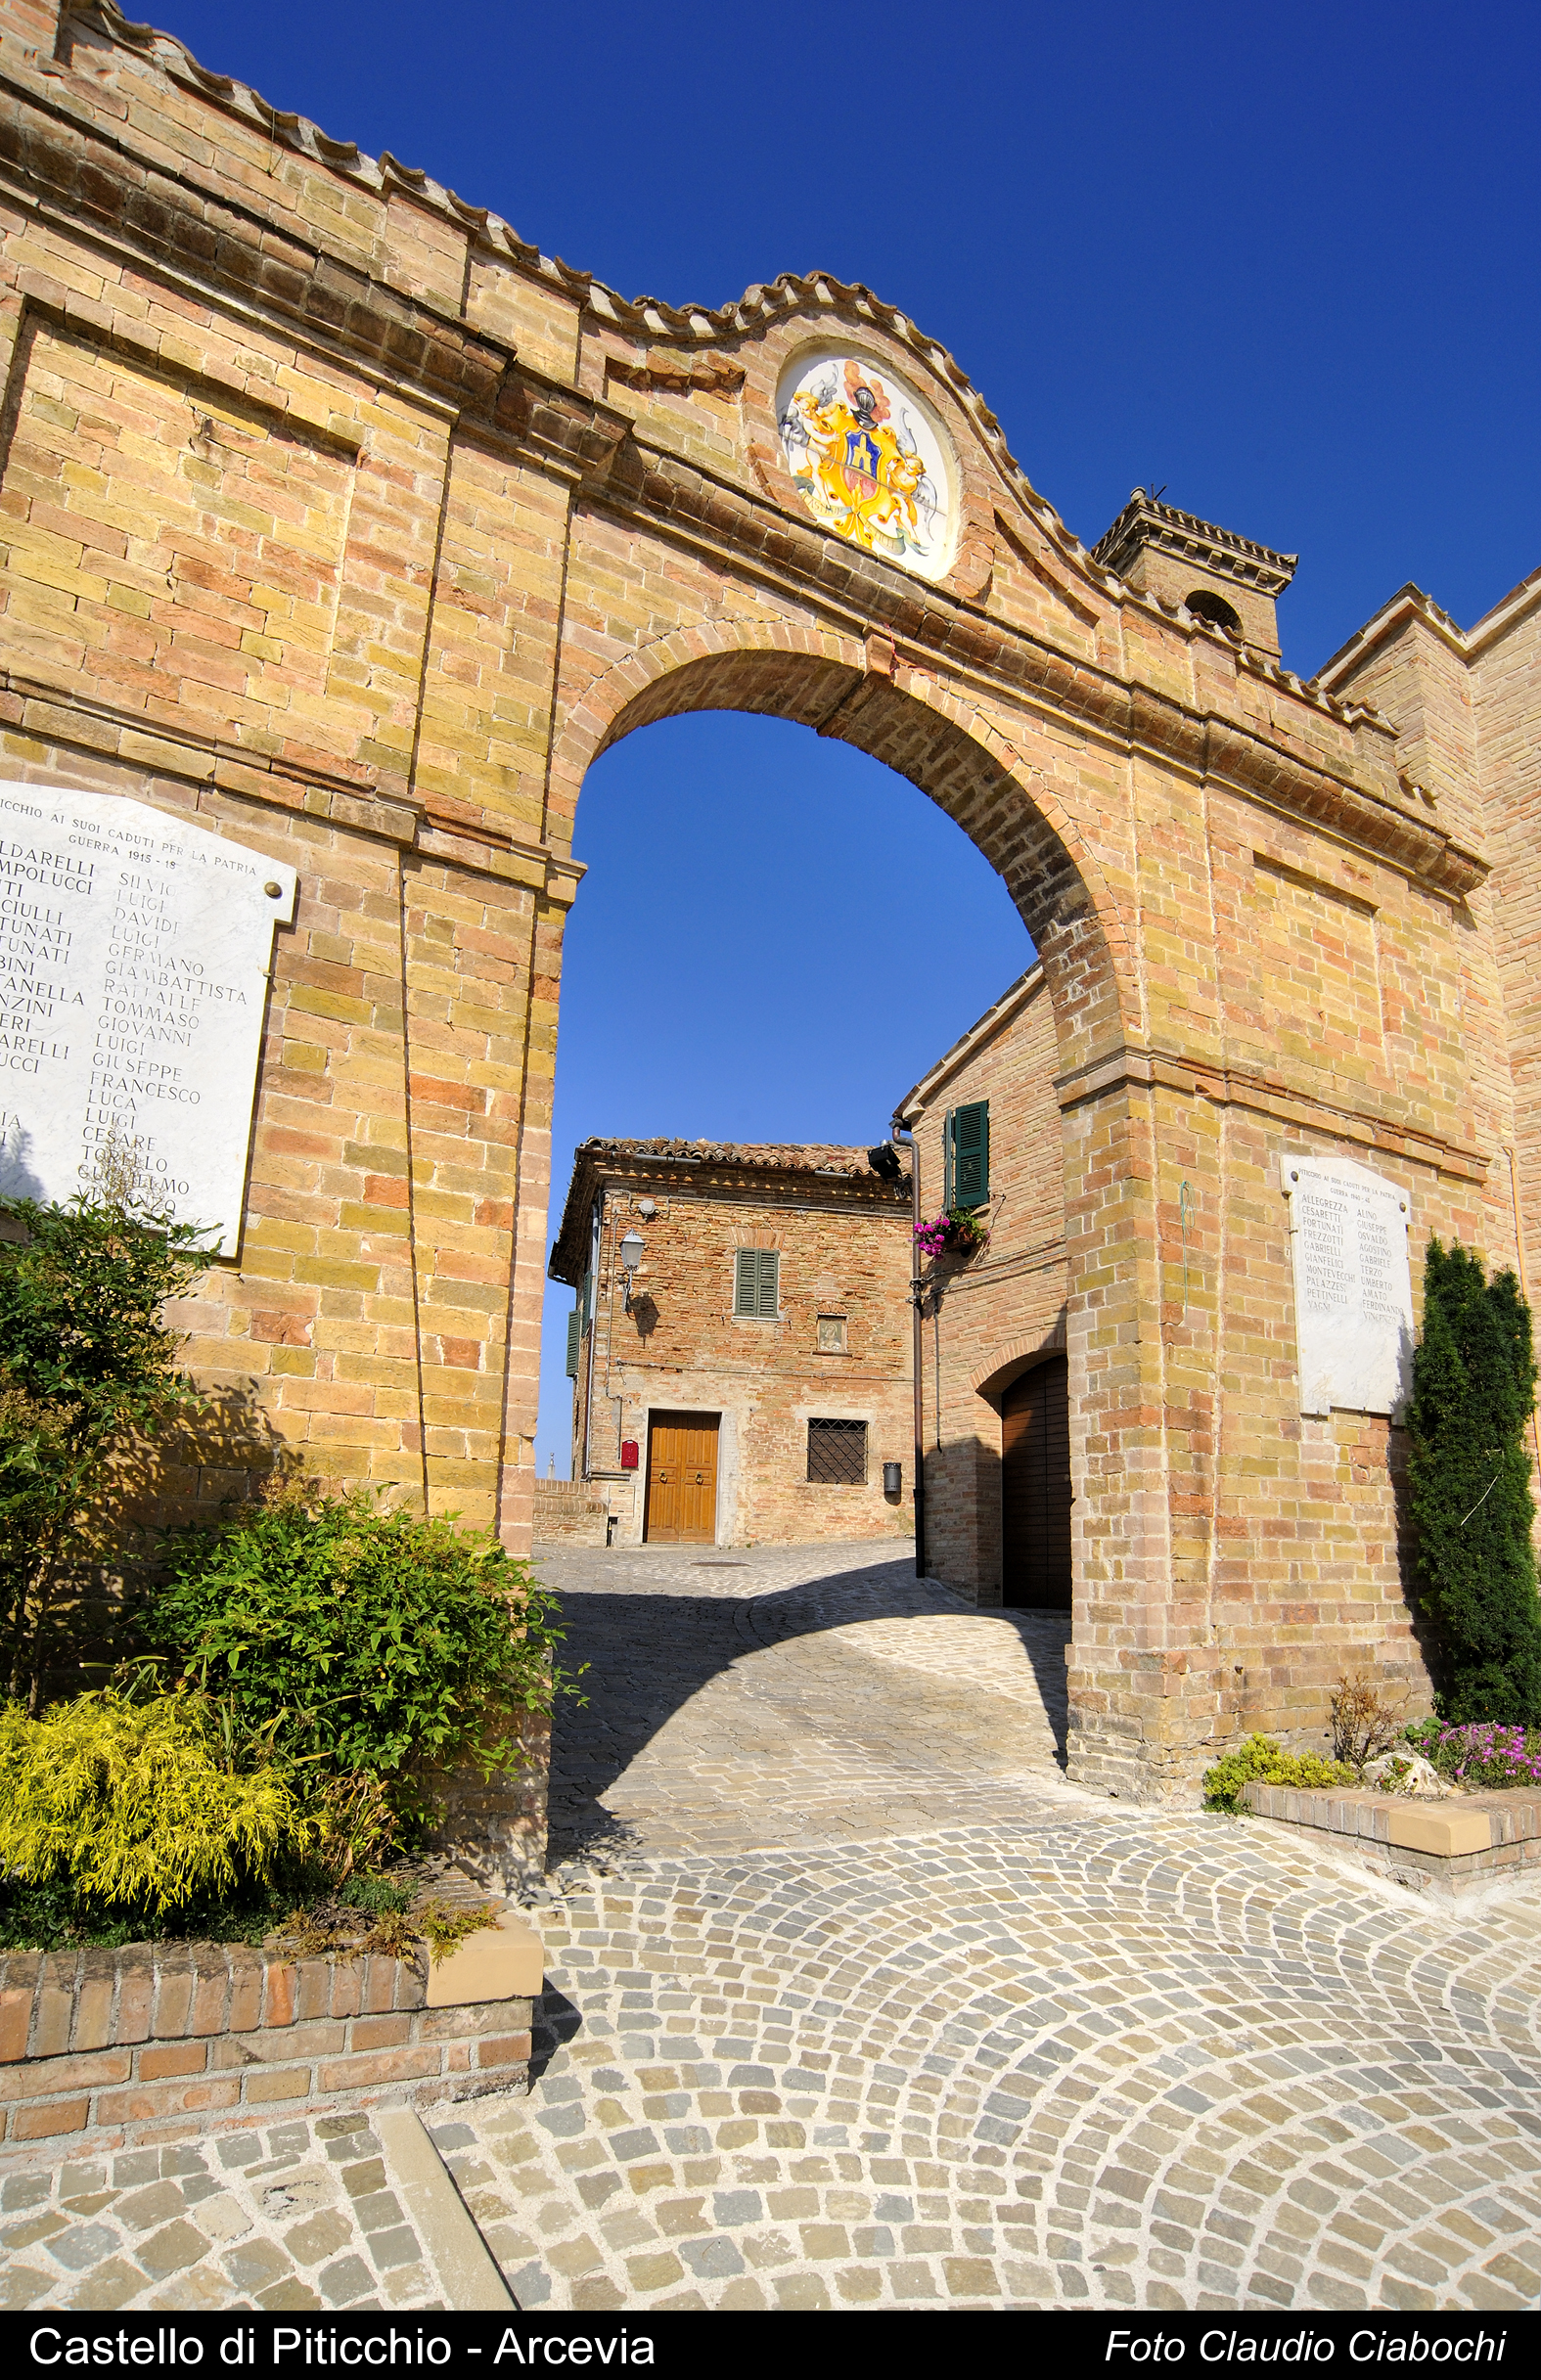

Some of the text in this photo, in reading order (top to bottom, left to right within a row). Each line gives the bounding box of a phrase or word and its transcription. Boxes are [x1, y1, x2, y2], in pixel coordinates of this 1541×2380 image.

[50, 814, 65, 824] AI
[71, 819, 101, 833] SUOI
[108, 829, 154, 848] CADUTI
[192, 851, 206, 863] LA
[214, 857, 256, 876] PATRIA
[68, 834, 119, 855] GUERRA
[129, 850, 152, 864] 1915
[1, 899, 159, 949] CIULLI LUIGI
[105, 960, 248, 1006] GIAMBATTISTA
[102, 996, 200, 1029] TOMMASO
[95, 1033, 145, 1056] LUIGI
[98, 1014, 192, 1047] GIOVANNI
[92, 1052, 183, 1083] GIUSEPPE
[88, 1089, 137, 1111] LUCA
[90, 1070, 201, 1104] FRANCESCO
[85, 1107, 135, 1130] LUIGI
[82, 1126, 158, 1151] CESARE
[80, 1145, 167, 1172] TORELLO
[77, 1164, 190, 1195] GUIELMO
[1298, 1167, 1321, 1180] PITICCHIO
[1331, 1177, 1341, 1186] SUOI
[1343, 1179, 1360, 1190] CADUTI
[1361, 1185, 1371, 1193] PER
[1330, 1187, 1348, 1197] GUERRA
[1301, 1193, 1378, 1221] ALLEGREZZA ALINO
[1301, 1205, 1387, 1235] CESARETTI GIUSEPPE
[1302, 1216, 1388, 1246] FORTUNATI OSVALDO
[1303, 1228, 1392, 1258] FREZZOTTI AGOSTINO
[1303, 1240, 1391, 1269] GABRIELLI GABRIELE
[1304, 1252, 1382, 1278] GIANFELICI TERZO
[1305, 1264, 1393, 1291] MONTEVECCHI UMBERTO
[1306, 1276, 1387, 1301] PALAZZESI AMATO
[1306, 1287, 1404, 1315] PETTINELLI FERDINANDO
[1307, 1299, 1332, 1312] VAGNI
